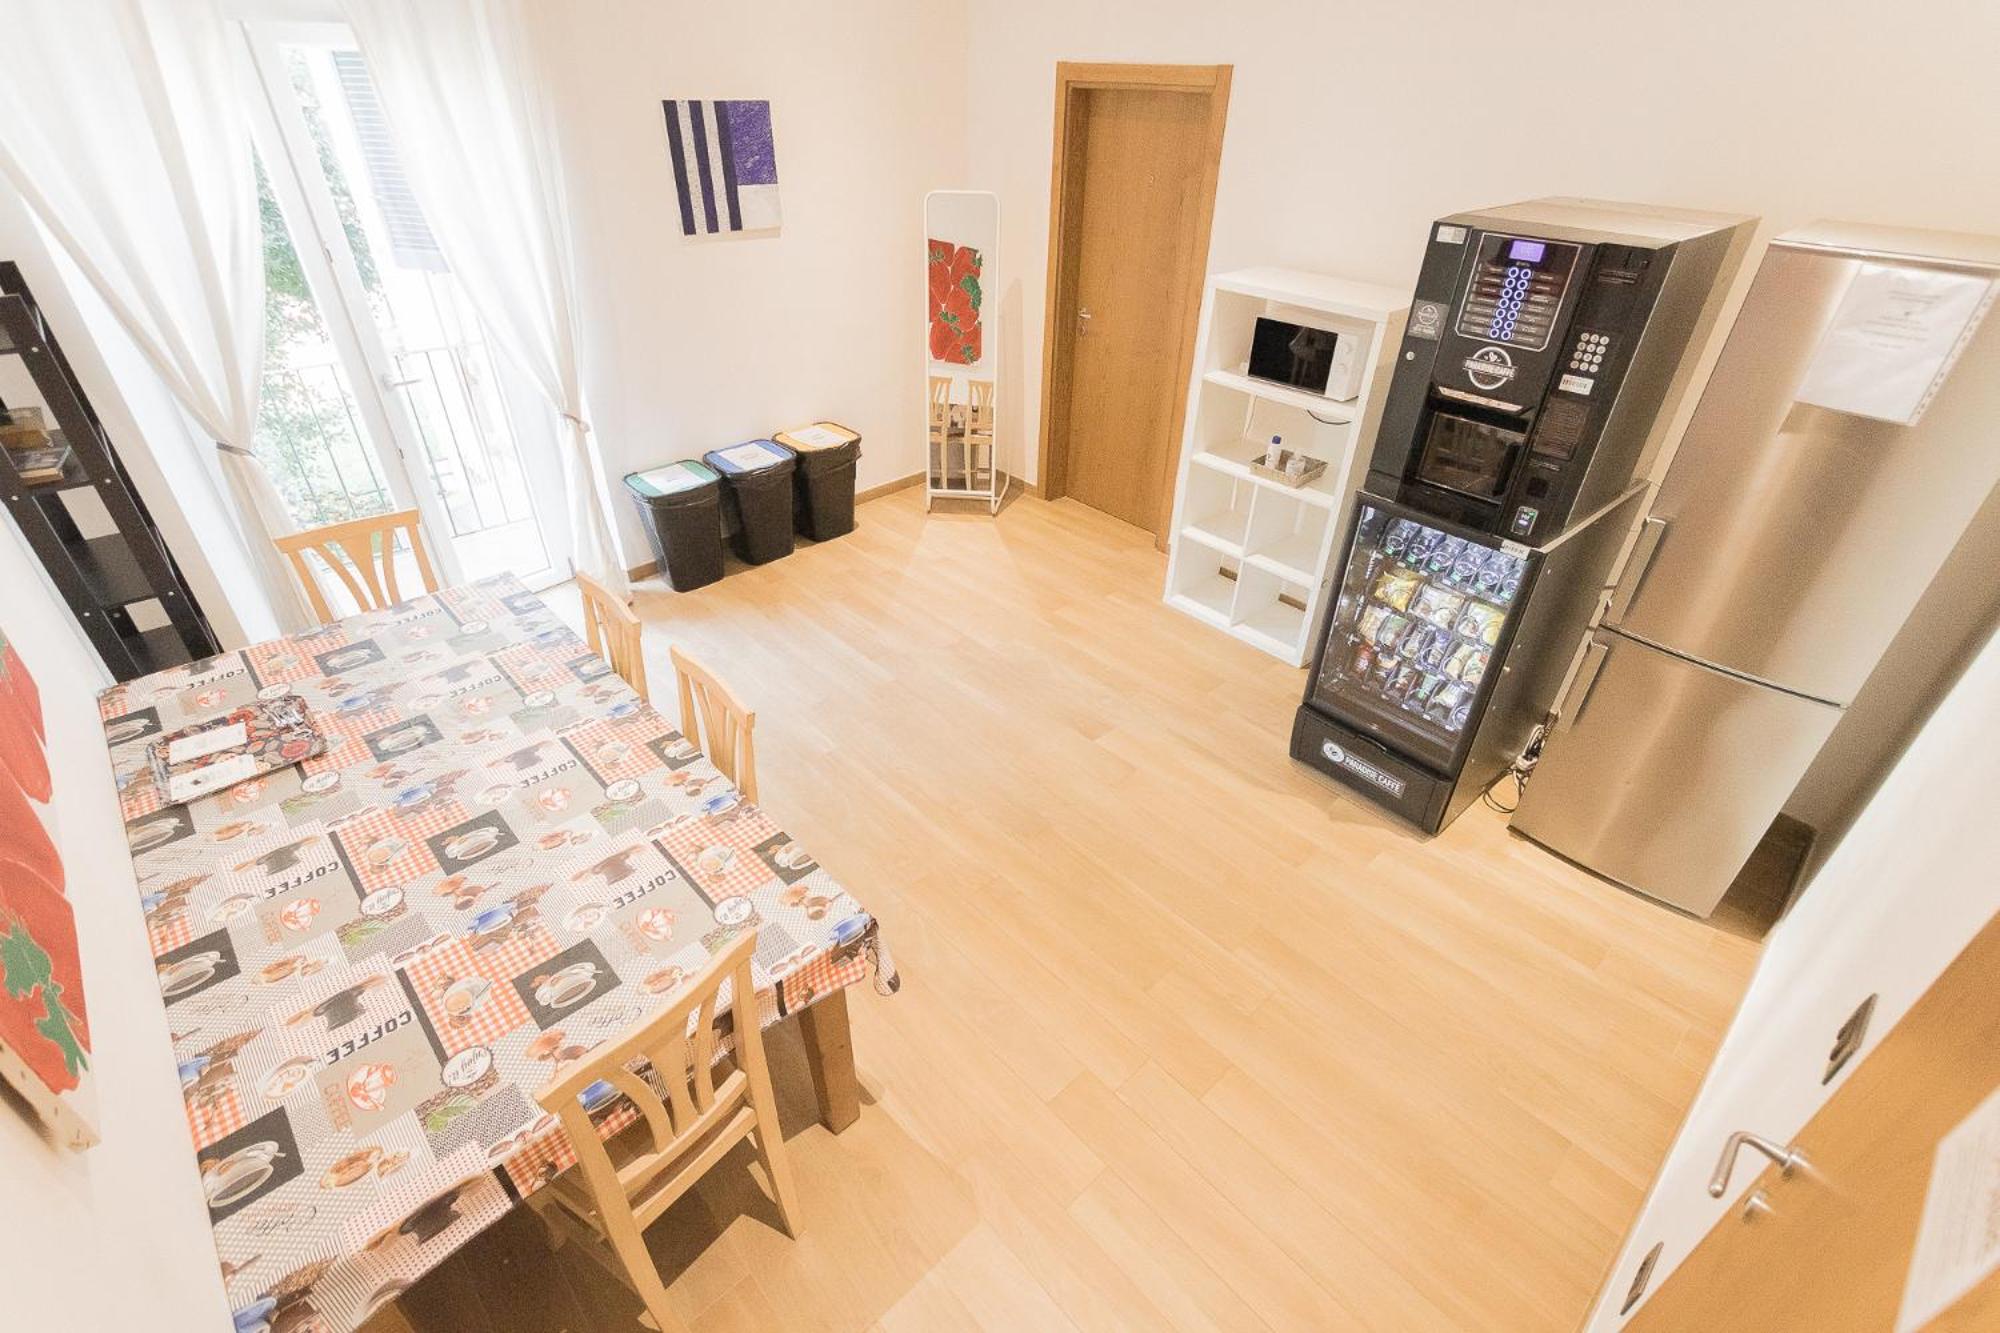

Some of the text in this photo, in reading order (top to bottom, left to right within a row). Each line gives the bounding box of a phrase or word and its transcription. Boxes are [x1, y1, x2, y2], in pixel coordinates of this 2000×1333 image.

[520, 759, 577, 788] COFFEE
[265, 860, 340, 898] COFFEE
[614, 870, 677, 910] COFFEE
[326, 1010, 412, 1066] COFFEE
